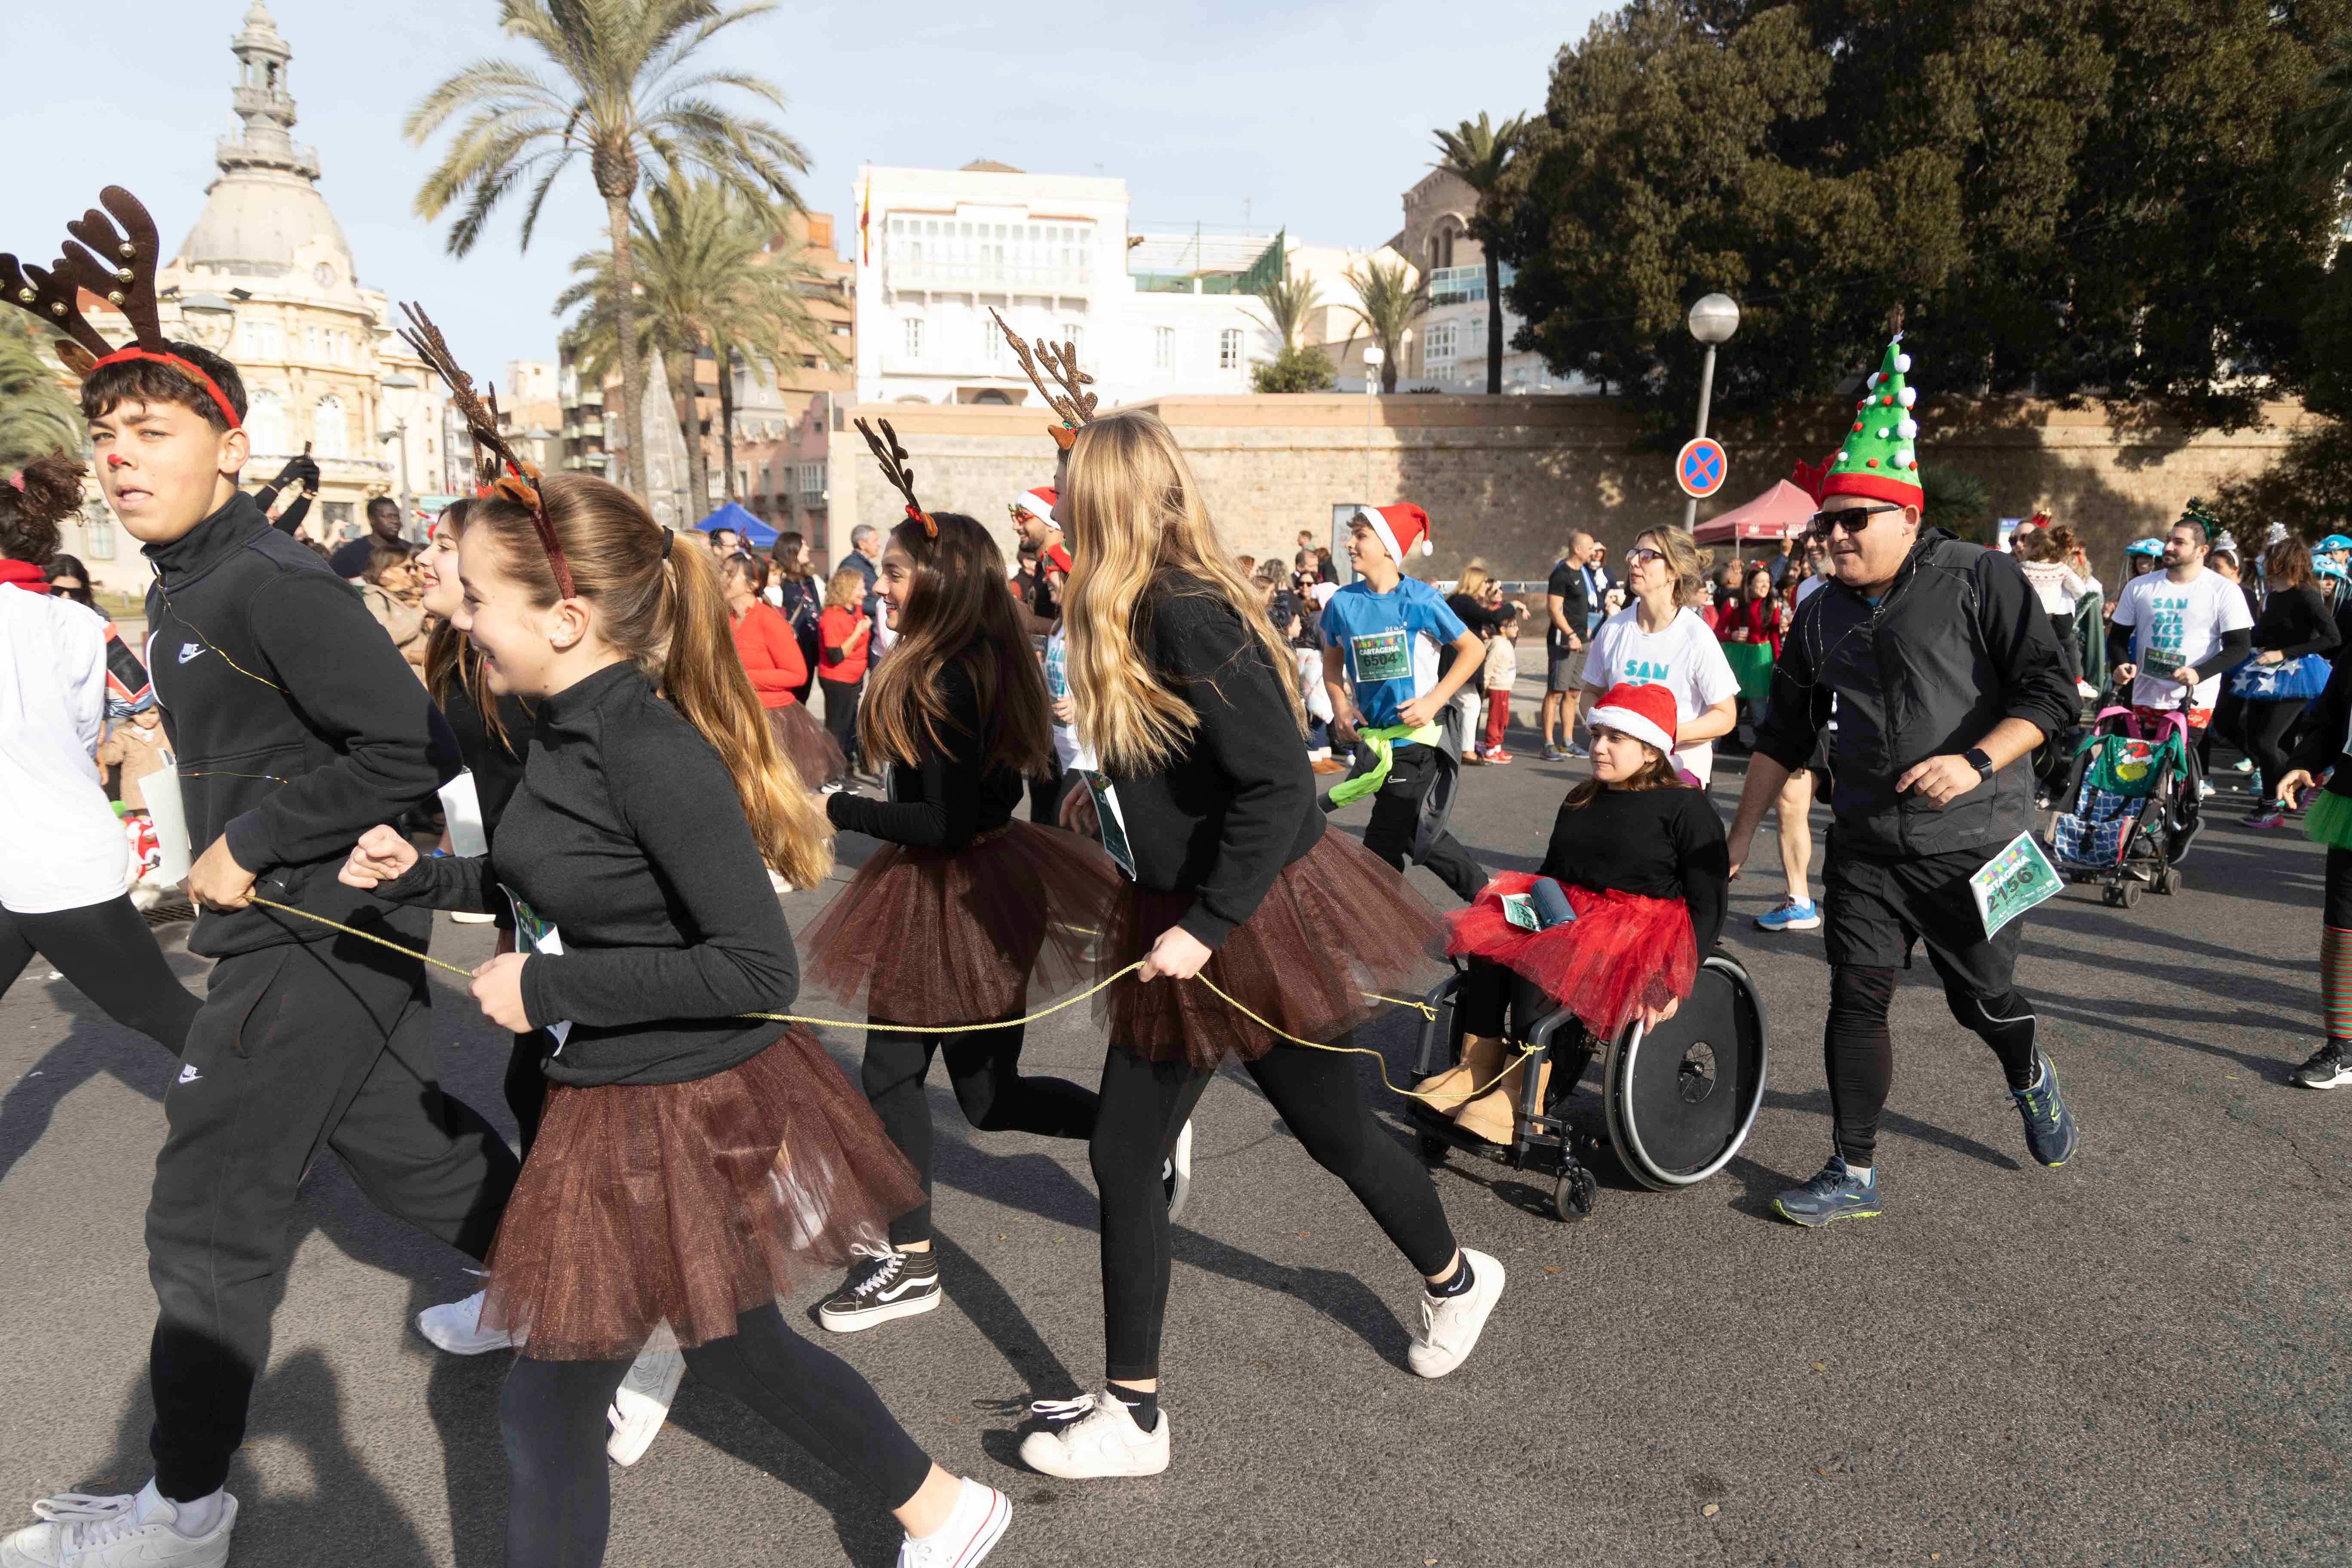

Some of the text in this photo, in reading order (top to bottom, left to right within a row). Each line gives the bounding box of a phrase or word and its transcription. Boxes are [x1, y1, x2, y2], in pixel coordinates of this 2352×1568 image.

[2152, 598, 2188, 609] SAN
[1359, 645, 1400, 656] CARTAGENA
[1364, 653, 1397, 667] 6504
[1623, 659, 1669, 680] SAN
[1986, 867, 2034, 914] 2156
